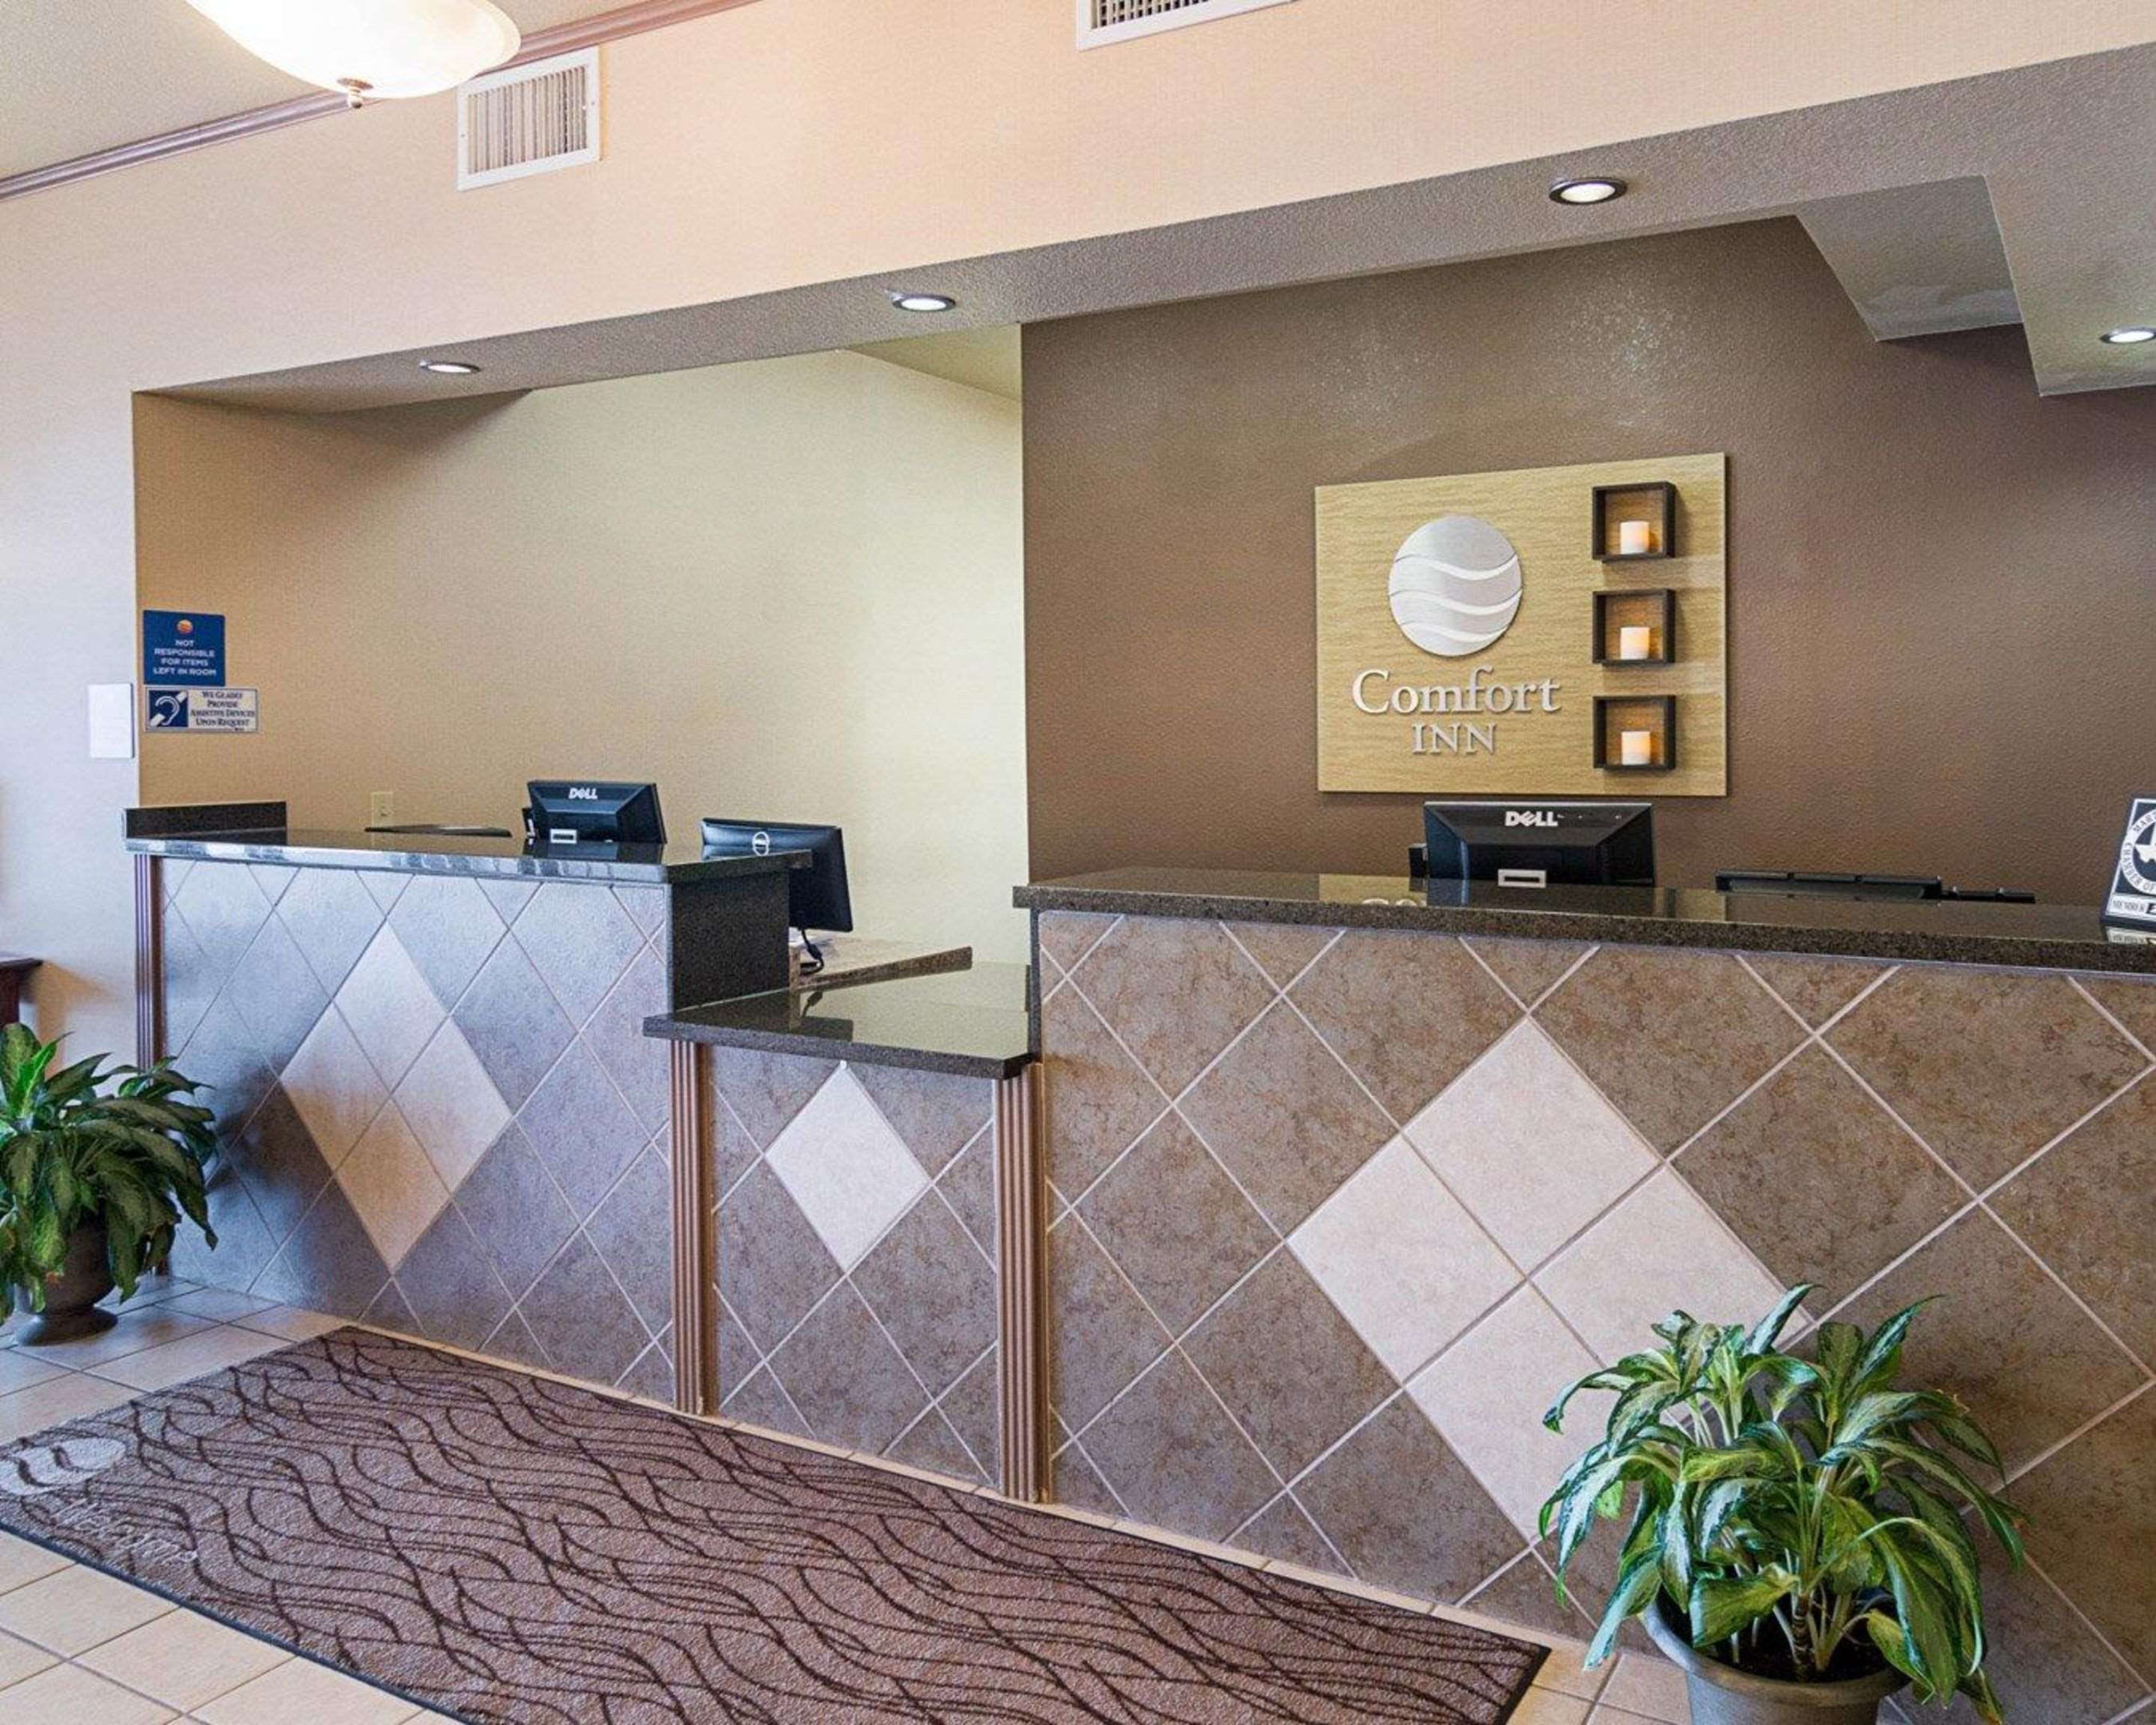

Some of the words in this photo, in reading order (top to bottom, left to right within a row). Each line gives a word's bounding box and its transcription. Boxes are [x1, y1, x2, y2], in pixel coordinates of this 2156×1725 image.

[153, 648, 215, 657] RESPONSIBLE
[189, 668, 216, 676] ROOM
[1351, 665, 1562, 714] Comfort
[1412, 722, 1497, 755] INN
[568, 788, 598, 800] DELL
[1505, 810, 1559, 827] DELL
